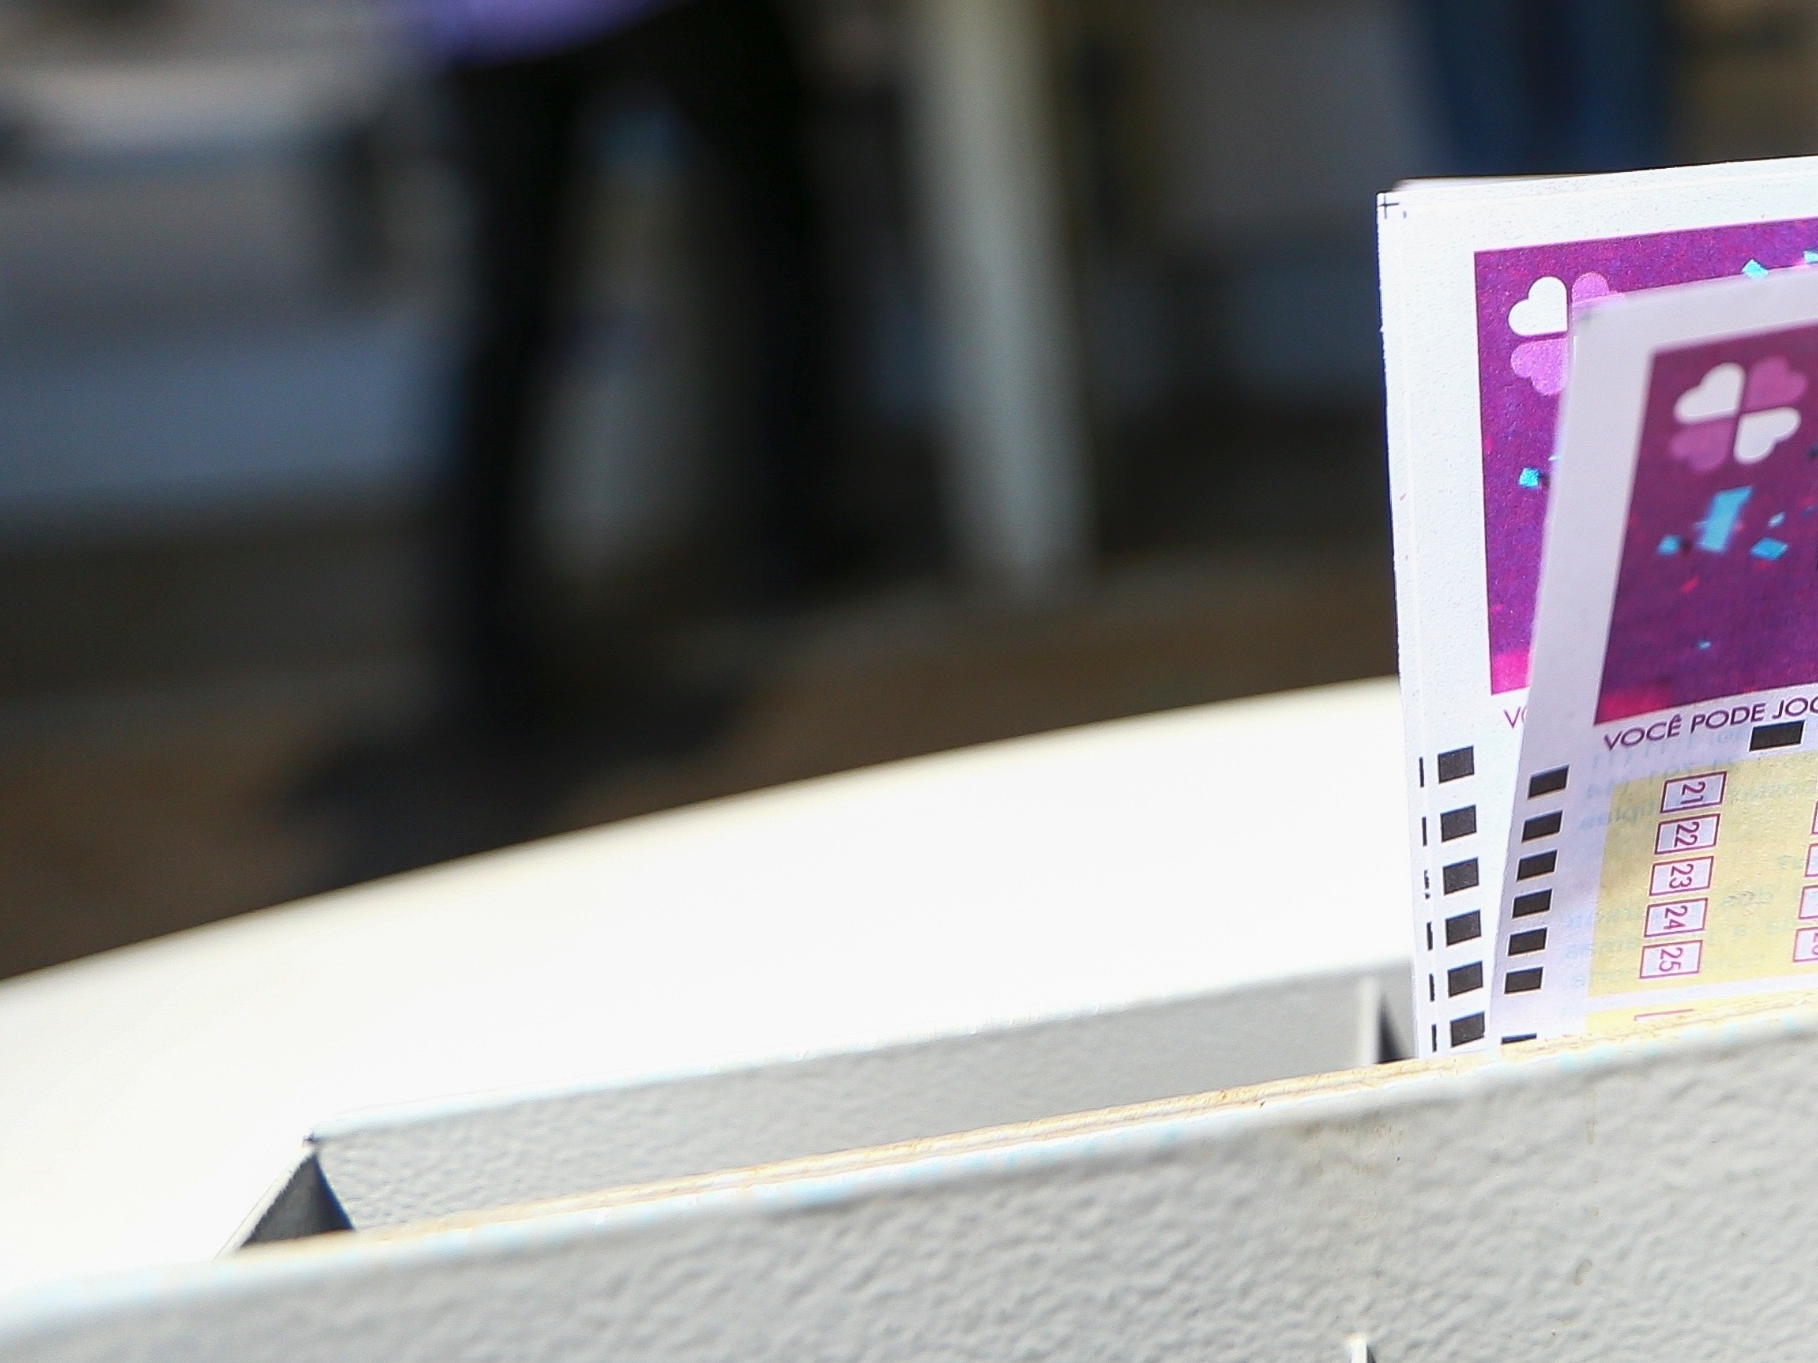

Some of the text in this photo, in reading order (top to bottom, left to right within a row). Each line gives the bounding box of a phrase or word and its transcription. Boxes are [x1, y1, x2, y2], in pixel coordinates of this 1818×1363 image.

[1604, 714, 1681, 750] VOCÊ
[1690, 703, 1766, 734] PODE
[1658, 780, 1707, 972] 21 22 23 24 25
